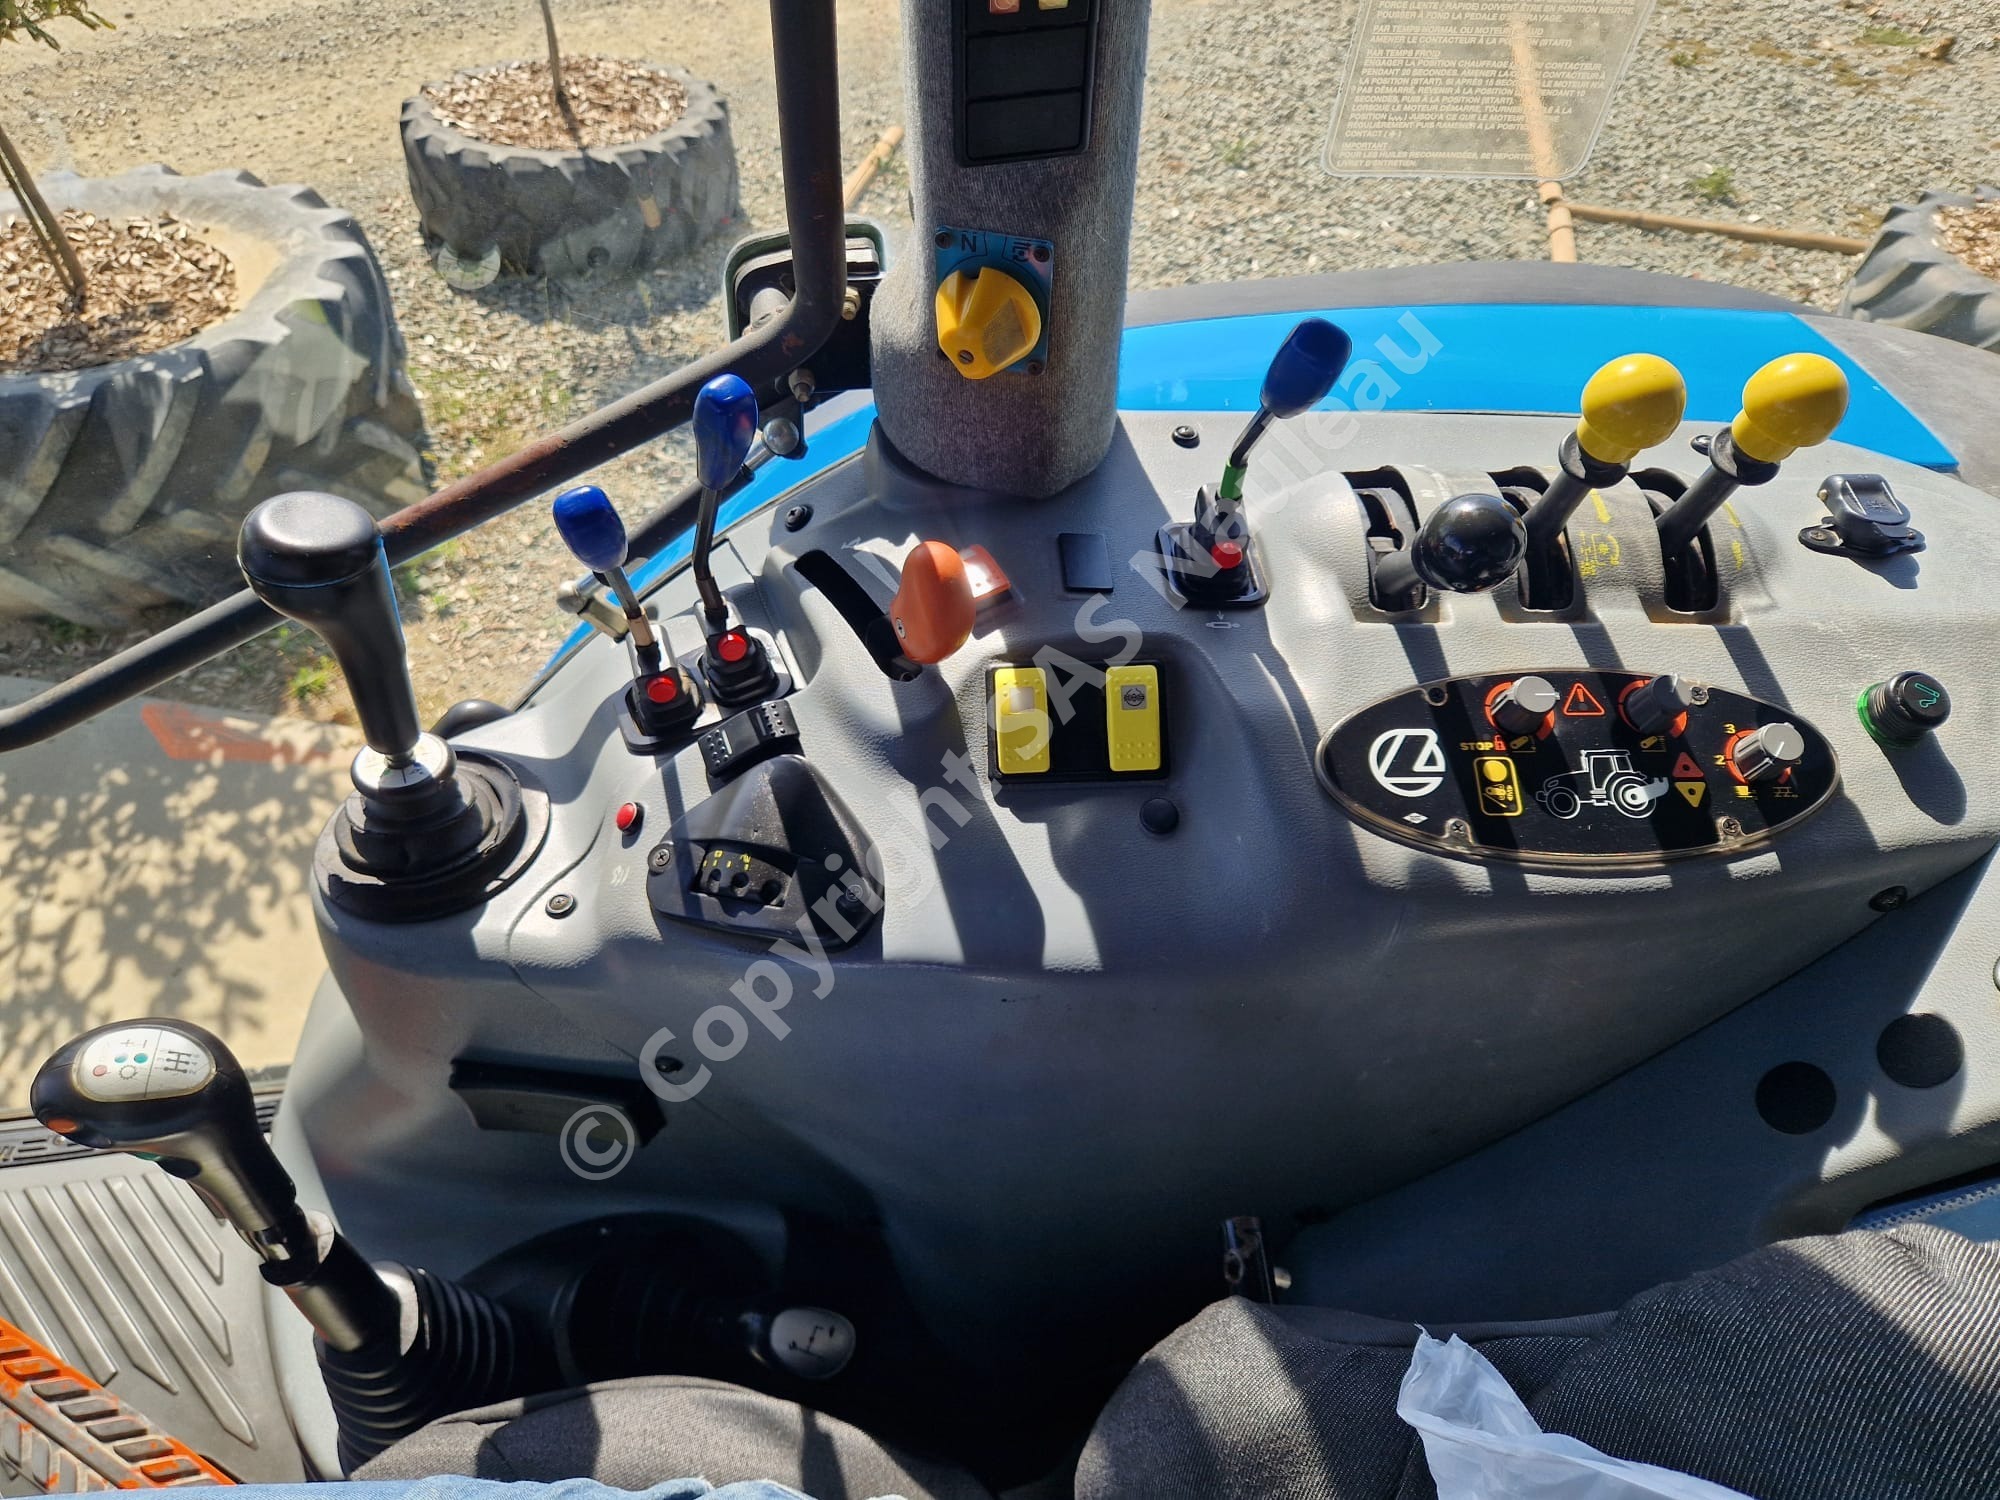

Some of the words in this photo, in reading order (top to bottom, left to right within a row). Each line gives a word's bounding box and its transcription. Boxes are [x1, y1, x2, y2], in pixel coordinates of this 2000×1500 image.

[1558, 4, 1599, 14] POSITION
[1722, 723, 1736, 734] 3
[1459, 741, 1494, 751] STOP
[1713, 754, 1727, 765] 2
